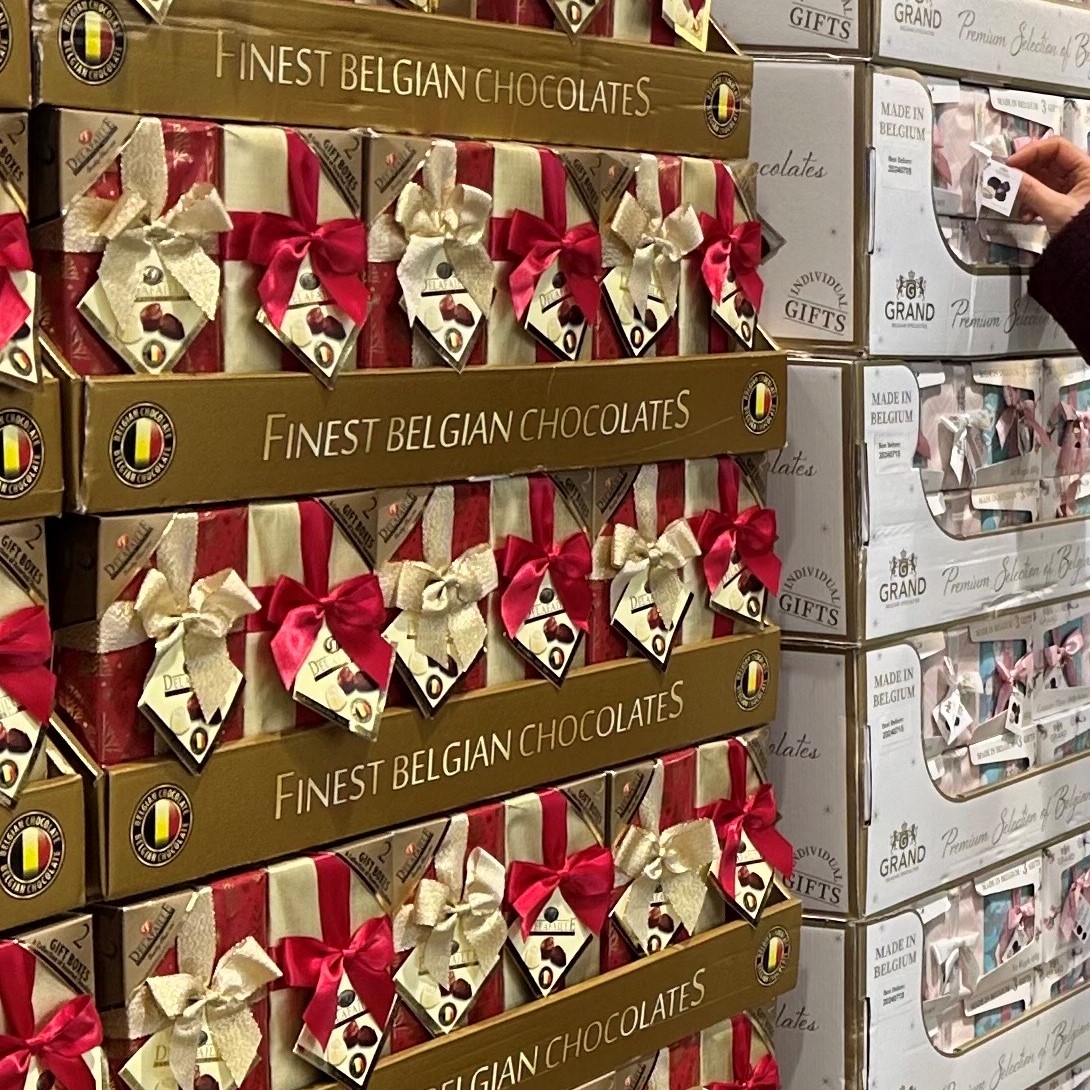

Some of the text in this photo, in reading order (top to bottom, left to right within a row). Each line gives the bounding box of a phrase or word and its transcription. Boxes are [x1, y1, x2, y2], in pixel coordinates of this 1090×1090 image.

[789, 6, 850, 40] GIFTS
[894, 4, 942, 29] GRAND
[957, 9, 1007, 47] Premium
[216, 29, 332, 88] FINEST
[341, 53, 466, 100] BELGIAN
[475, 68, 651, 118] CHOCOLATES
[880, 101, 924, 120] MADE IN
[879, 121, 925, 141] BELGIUM
[790, 271, 848, 309] INDIVIDUAL
[784, 299, 847, 332] GIFTS
[884, 300, 935, 321] GRAND
[951, 298, 1000, 329] Premium
[871, 390, 912, 406] MADE IN
[263, 413, 381, 461] FINEST
[387, 410, 513, 451] BELGIAN
[519, 389, 691, 441] CHOCOLATES
[871, 409, 913, 426] BELGIUM
[783, 566, 840, 602] INDIVIDUAL
[879, 576, 926, 603] GRAND
[942, 565, 990, 596] Premium
[779, 593, 839, 627] GIFTS
[874, 667, 914, 688] MADE IN
[873, 685, 915, 707] BELGIUM
[275, 759, 386, 820] FINEST
[391, 729, 512, 790] BELGIAN
[519, 680, 685, 757] CHOCOLATES
[941, 828, 988, 858] Premium
[879, 845, 926, 877] GRAND
[782, 874, 841, 904] GIFTS
[73, 924, 89, 948] 2
[875, 933, 916, 960] MADE IN
[50, 939, 90, 982] GIFT BOXES
[874, 951, 917, 979] BELGIUM
[545, 968, 706, 1069] CHOCOLATES
